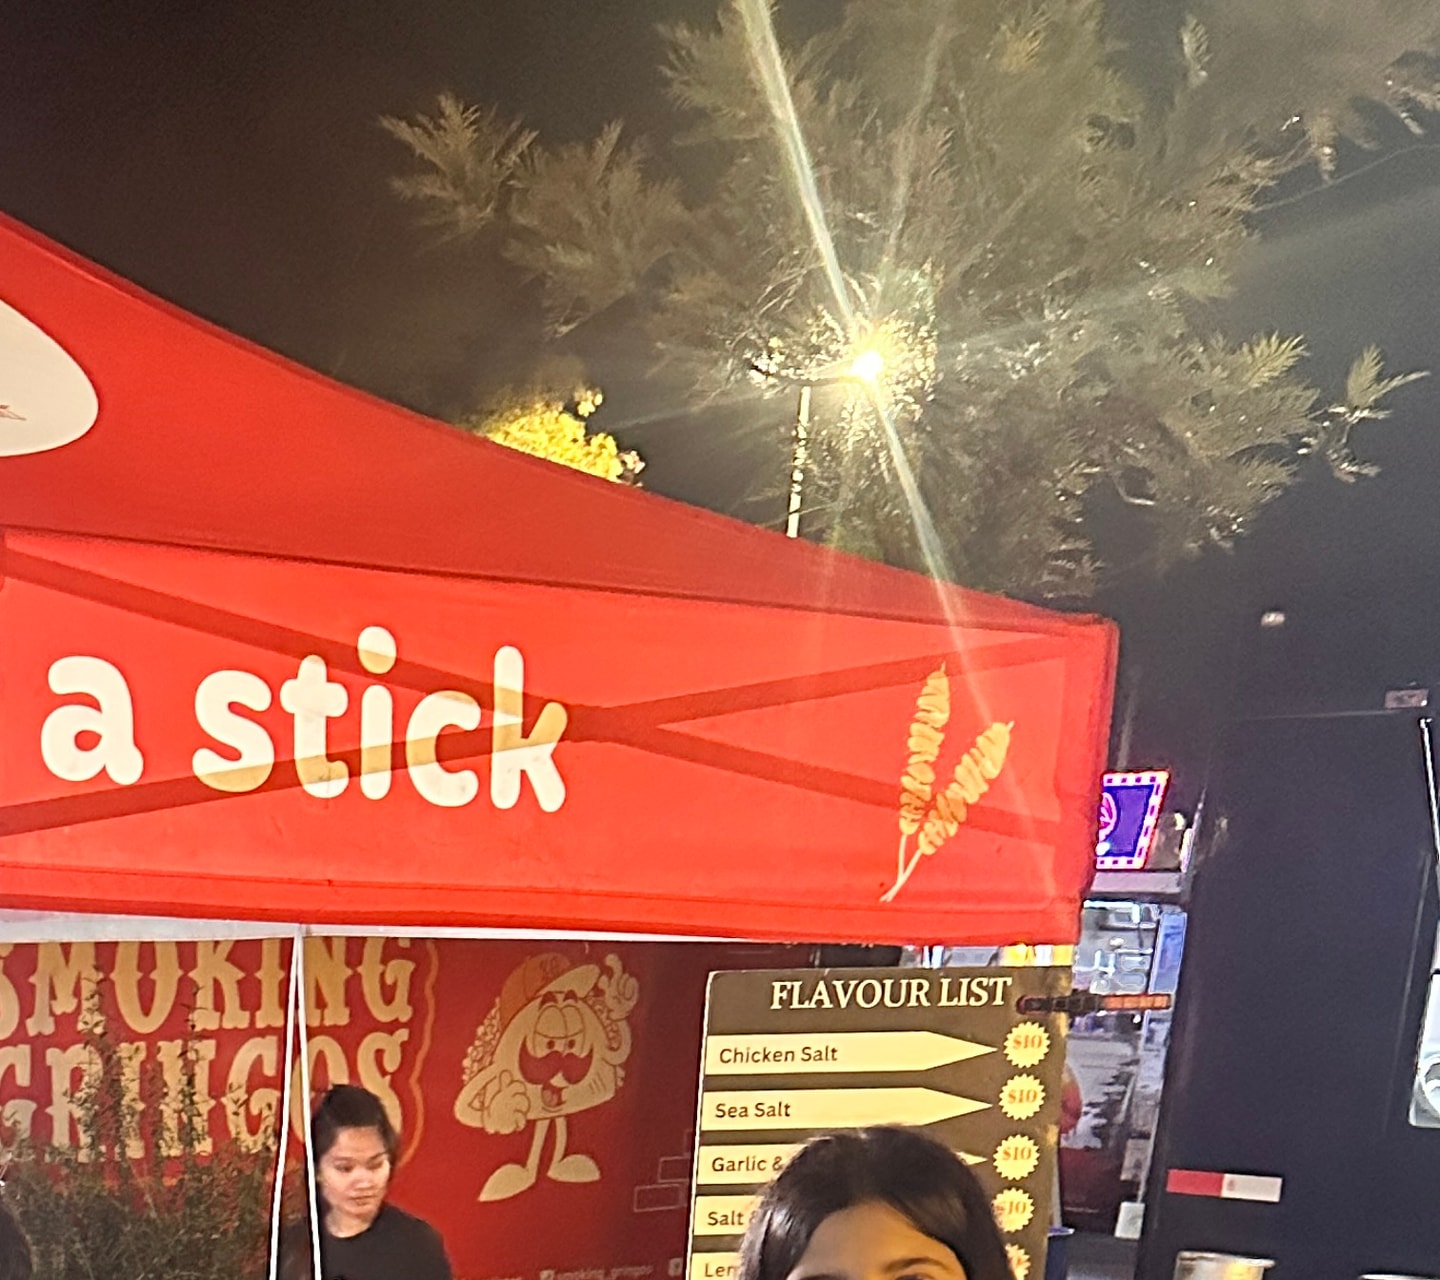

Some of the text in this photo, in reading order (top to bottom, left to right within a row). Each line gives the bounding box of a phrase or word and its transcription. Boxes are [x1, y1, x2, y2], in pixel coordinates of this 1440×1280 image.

[40, 655, 144, 786] a
[191, 625, 569, 813] stick
[770, 976, 1013, 1010] FLAVOUR LIST
[1012, 1034, 1042, 1050] $10
[719, 1045, 838, 1064] Chicken Salt
[1007, 1089, 1038, 1104] $10
[715, 1101, 791, 1118] Sea Salt
[1002, 1146, 1032, 1161] $10
[711, 1155, 767, 1173] Garlic
[707, 1211, 744, 1226] Salt
